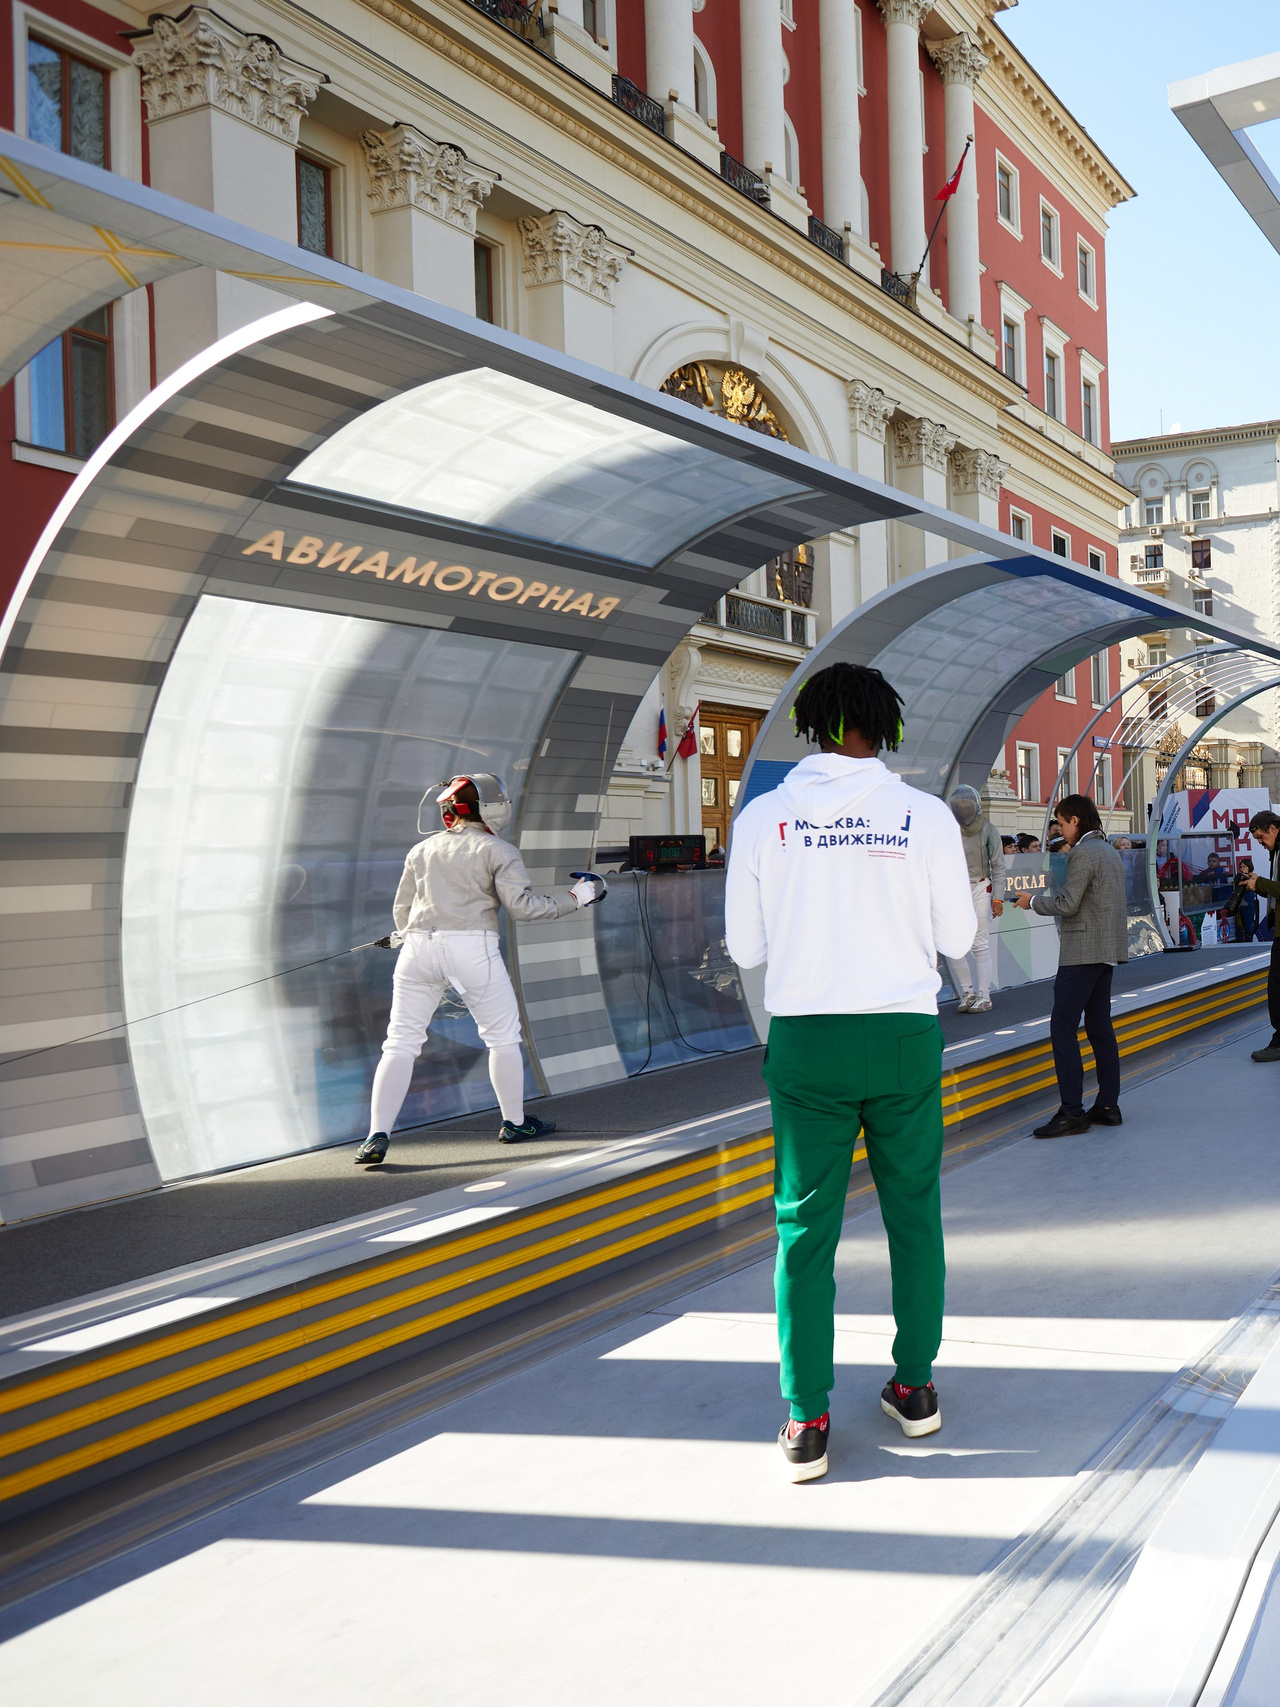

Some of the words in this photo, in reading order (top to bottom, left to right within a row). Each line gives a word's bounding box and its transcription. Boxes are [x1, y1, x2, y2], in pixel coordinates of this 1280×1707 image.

[241, 529, 621, 620] АВИАМОТОРНАЯ
[804, 835, 812, 847] В
[817, 833, 909, 849] ДВИЖЕНИИ
[646, 849, 654, 862] 4
[693, 847, 701, 861] 2
[1004, 874, 1046, 892] РСКАЯ
